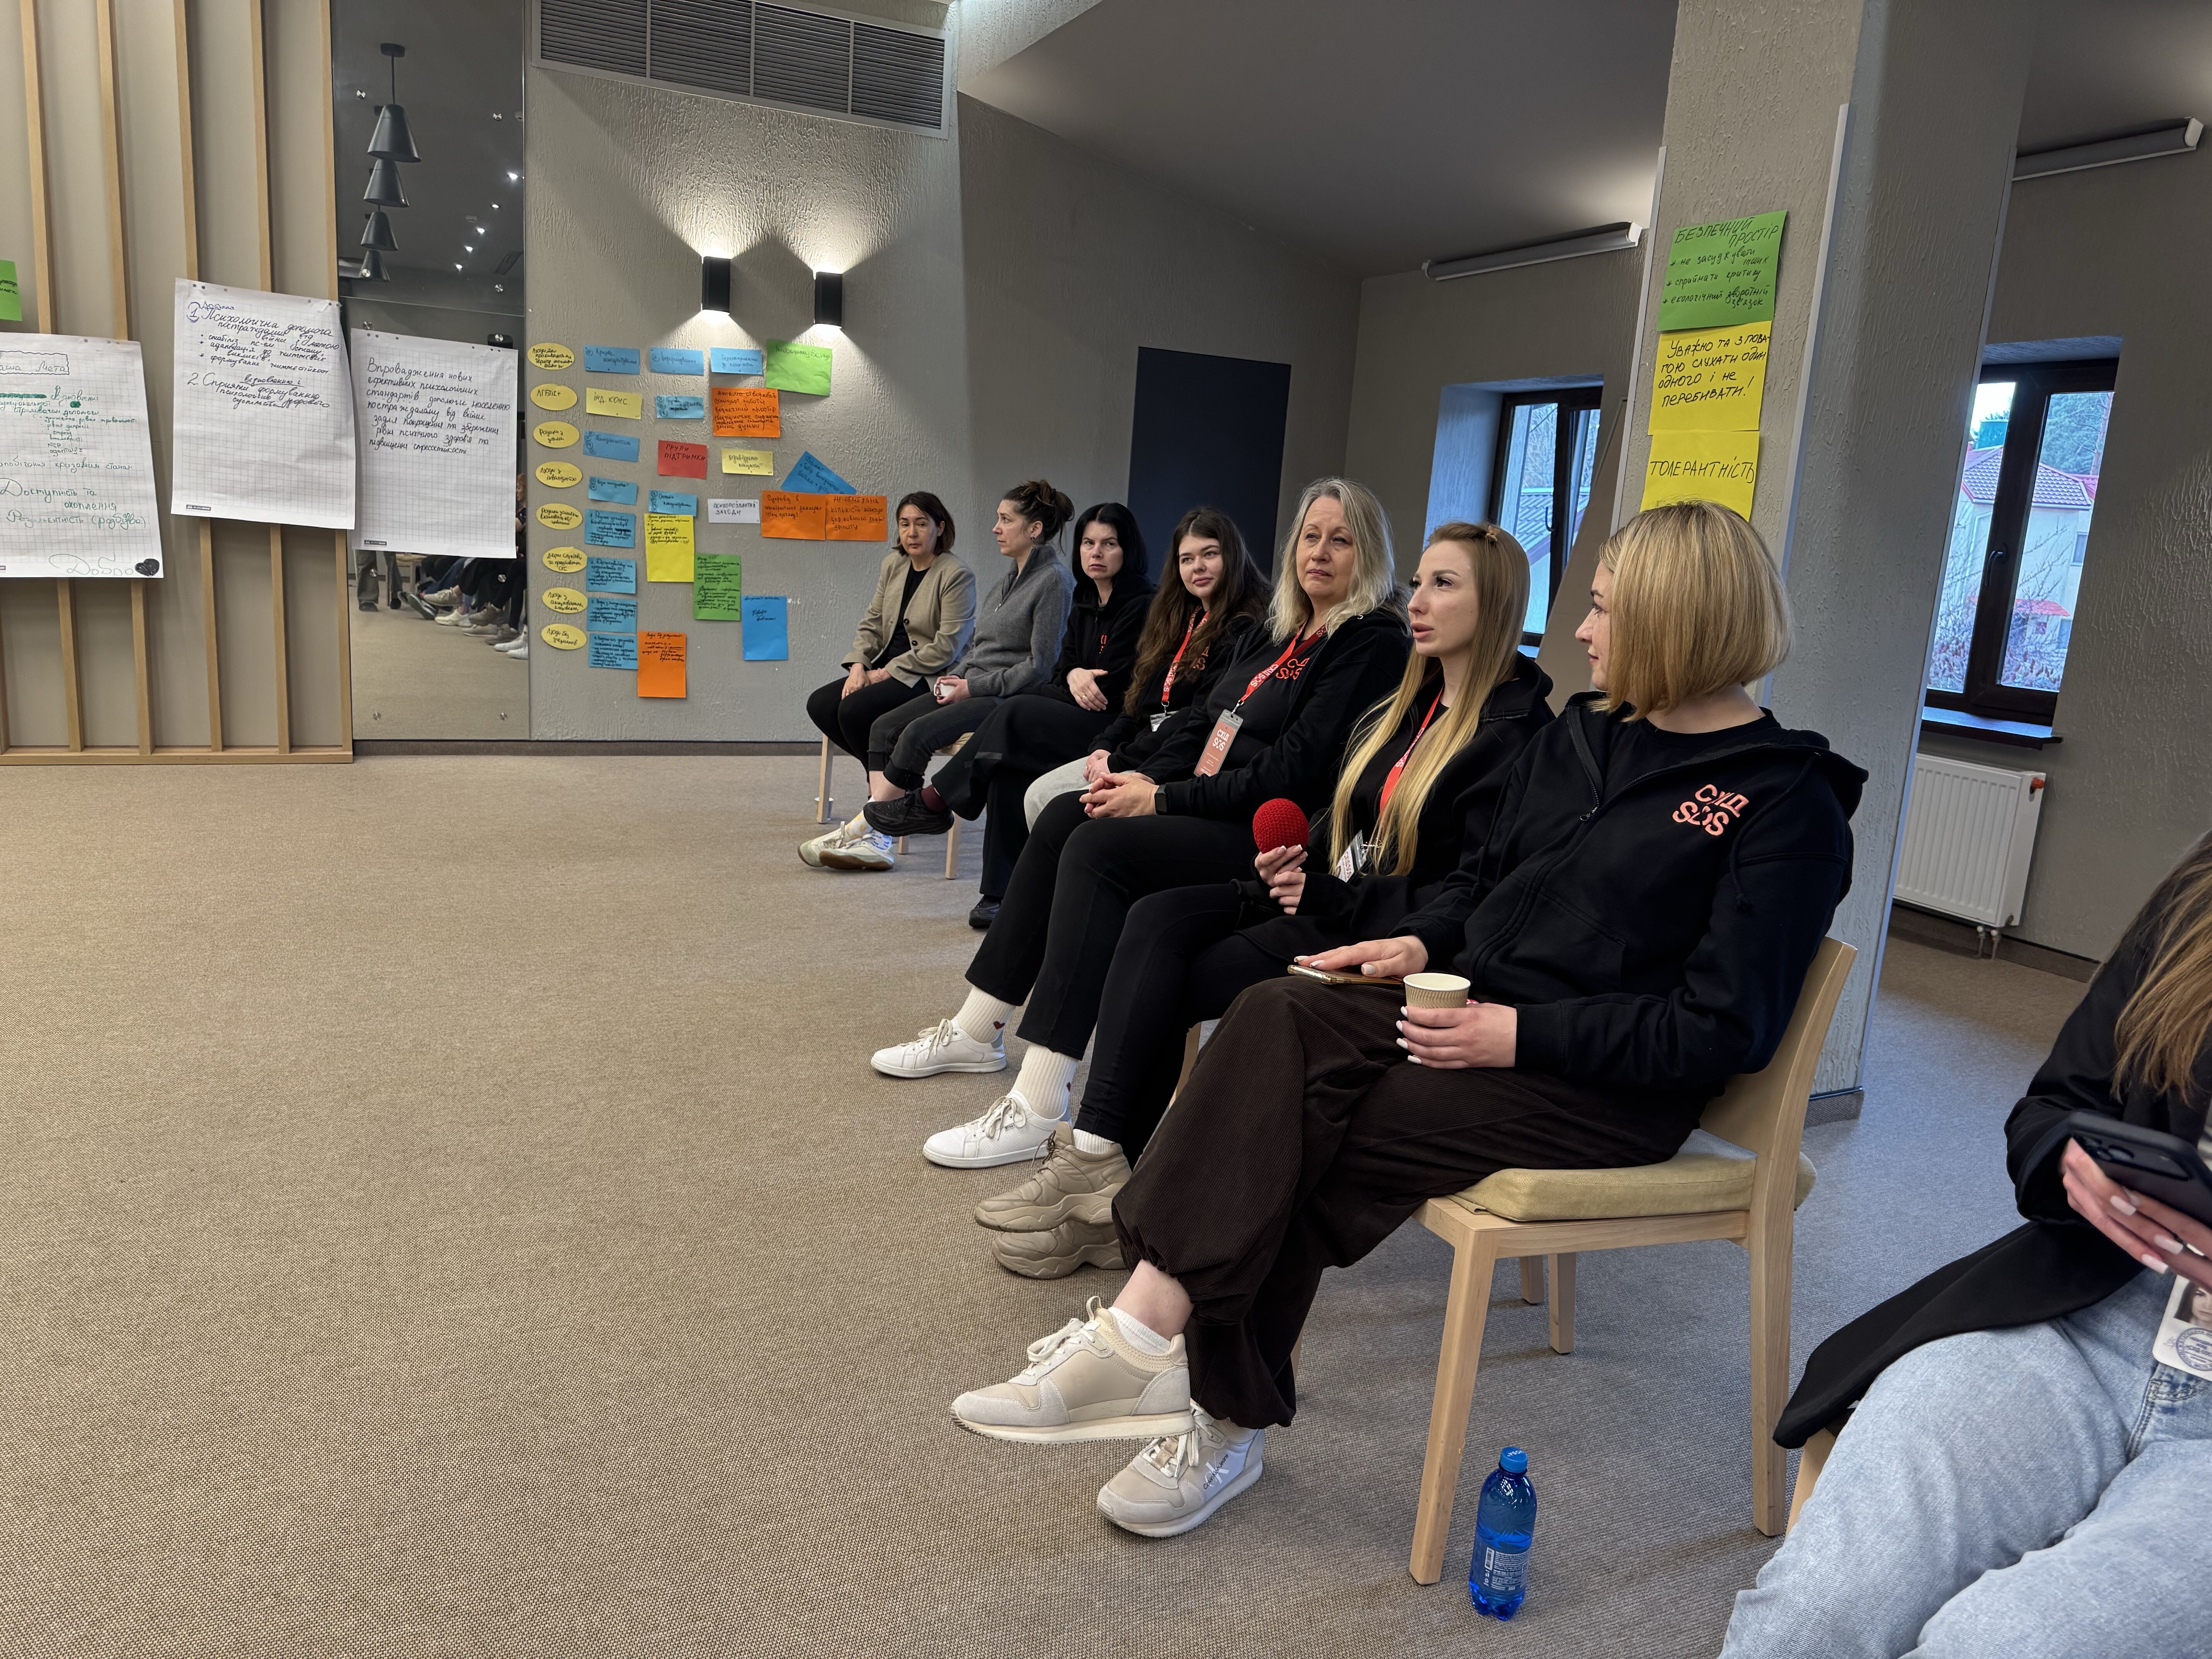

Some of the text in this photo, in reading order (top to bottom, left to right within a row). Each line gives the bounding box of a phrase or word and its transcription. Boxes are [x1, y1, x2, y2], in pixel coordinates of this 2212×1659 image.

[1675, 217, 1755, 244] БЕЗПЕЧНИЙ
[1729, 223, 1779, 248] ПРОСТІР
[1681, 257, 1689, 265] не
[367, 357, 472, 382] Впровадження нових
[366, 388, 419, 403] стандартів
[446, 407, 456, 418] від
[1650, 456, 1755, 483] ТОЛЕРАНТНІСТЬ
